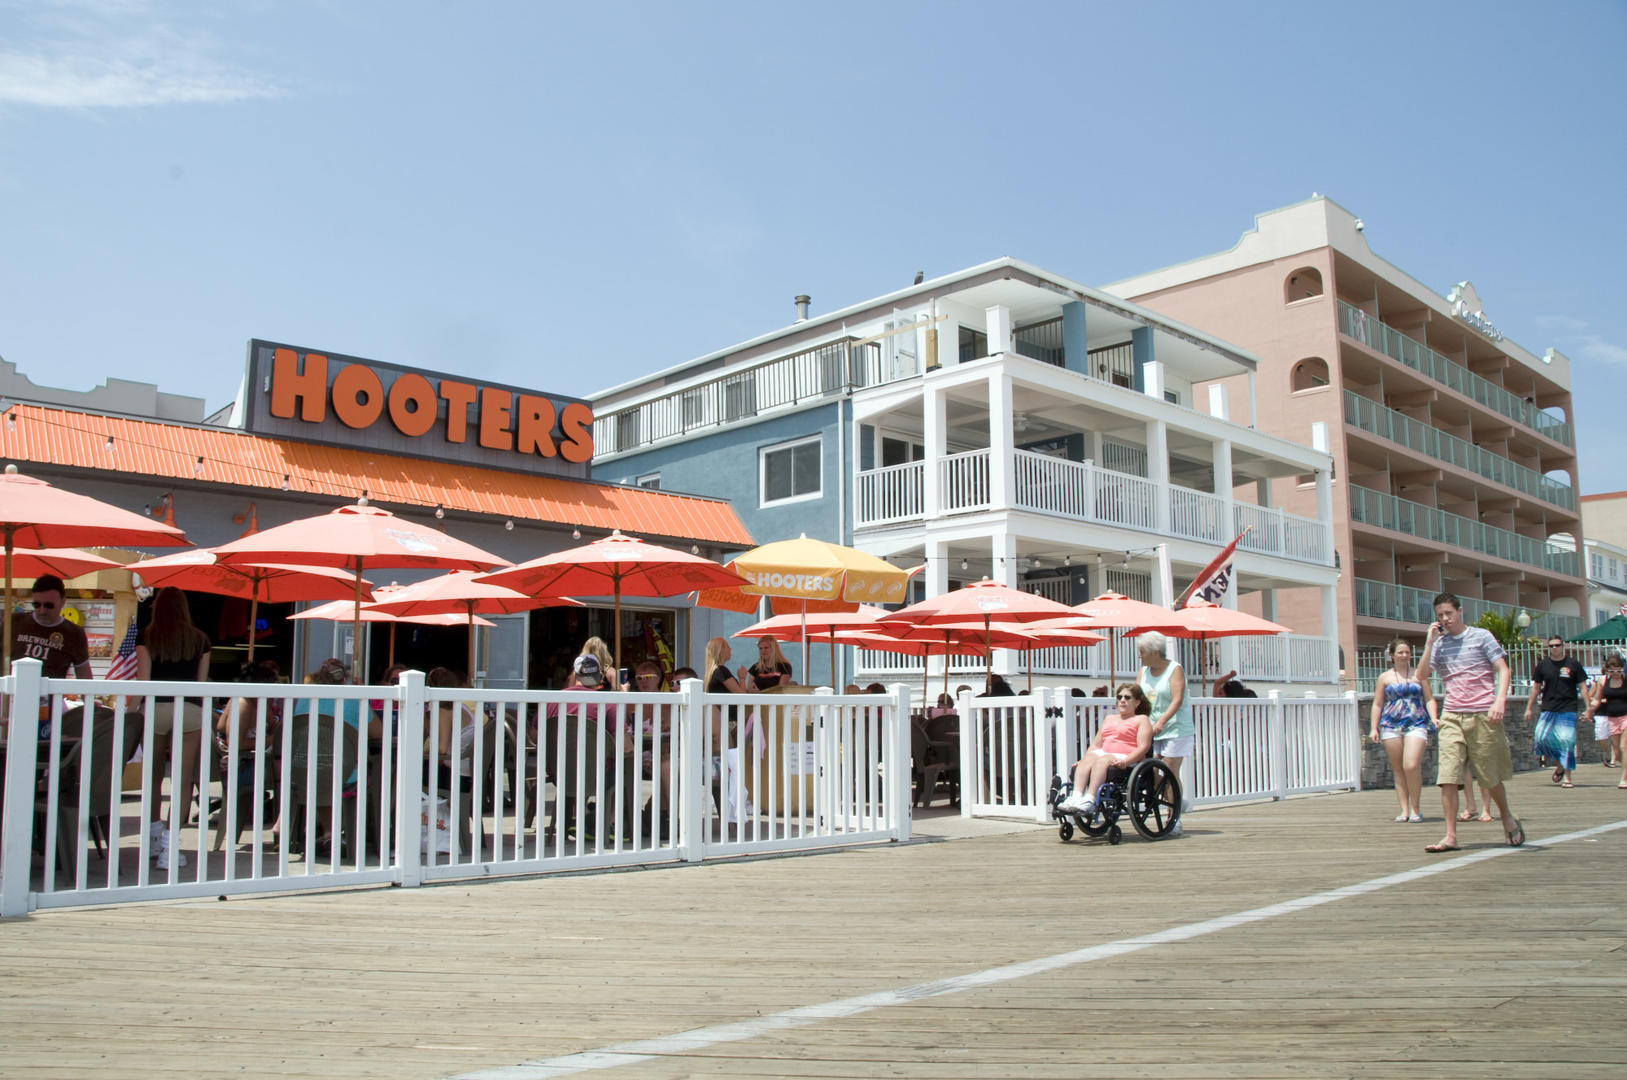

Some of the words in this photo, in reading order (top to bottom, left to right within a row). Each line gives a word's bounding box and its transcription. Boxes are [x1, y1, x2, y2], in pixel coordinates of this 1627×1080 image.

[271, 348, 594, 463] HOOTERS
[757, 572, 834, 592] HOOTERS
[24, 643, 50, 660] 101
